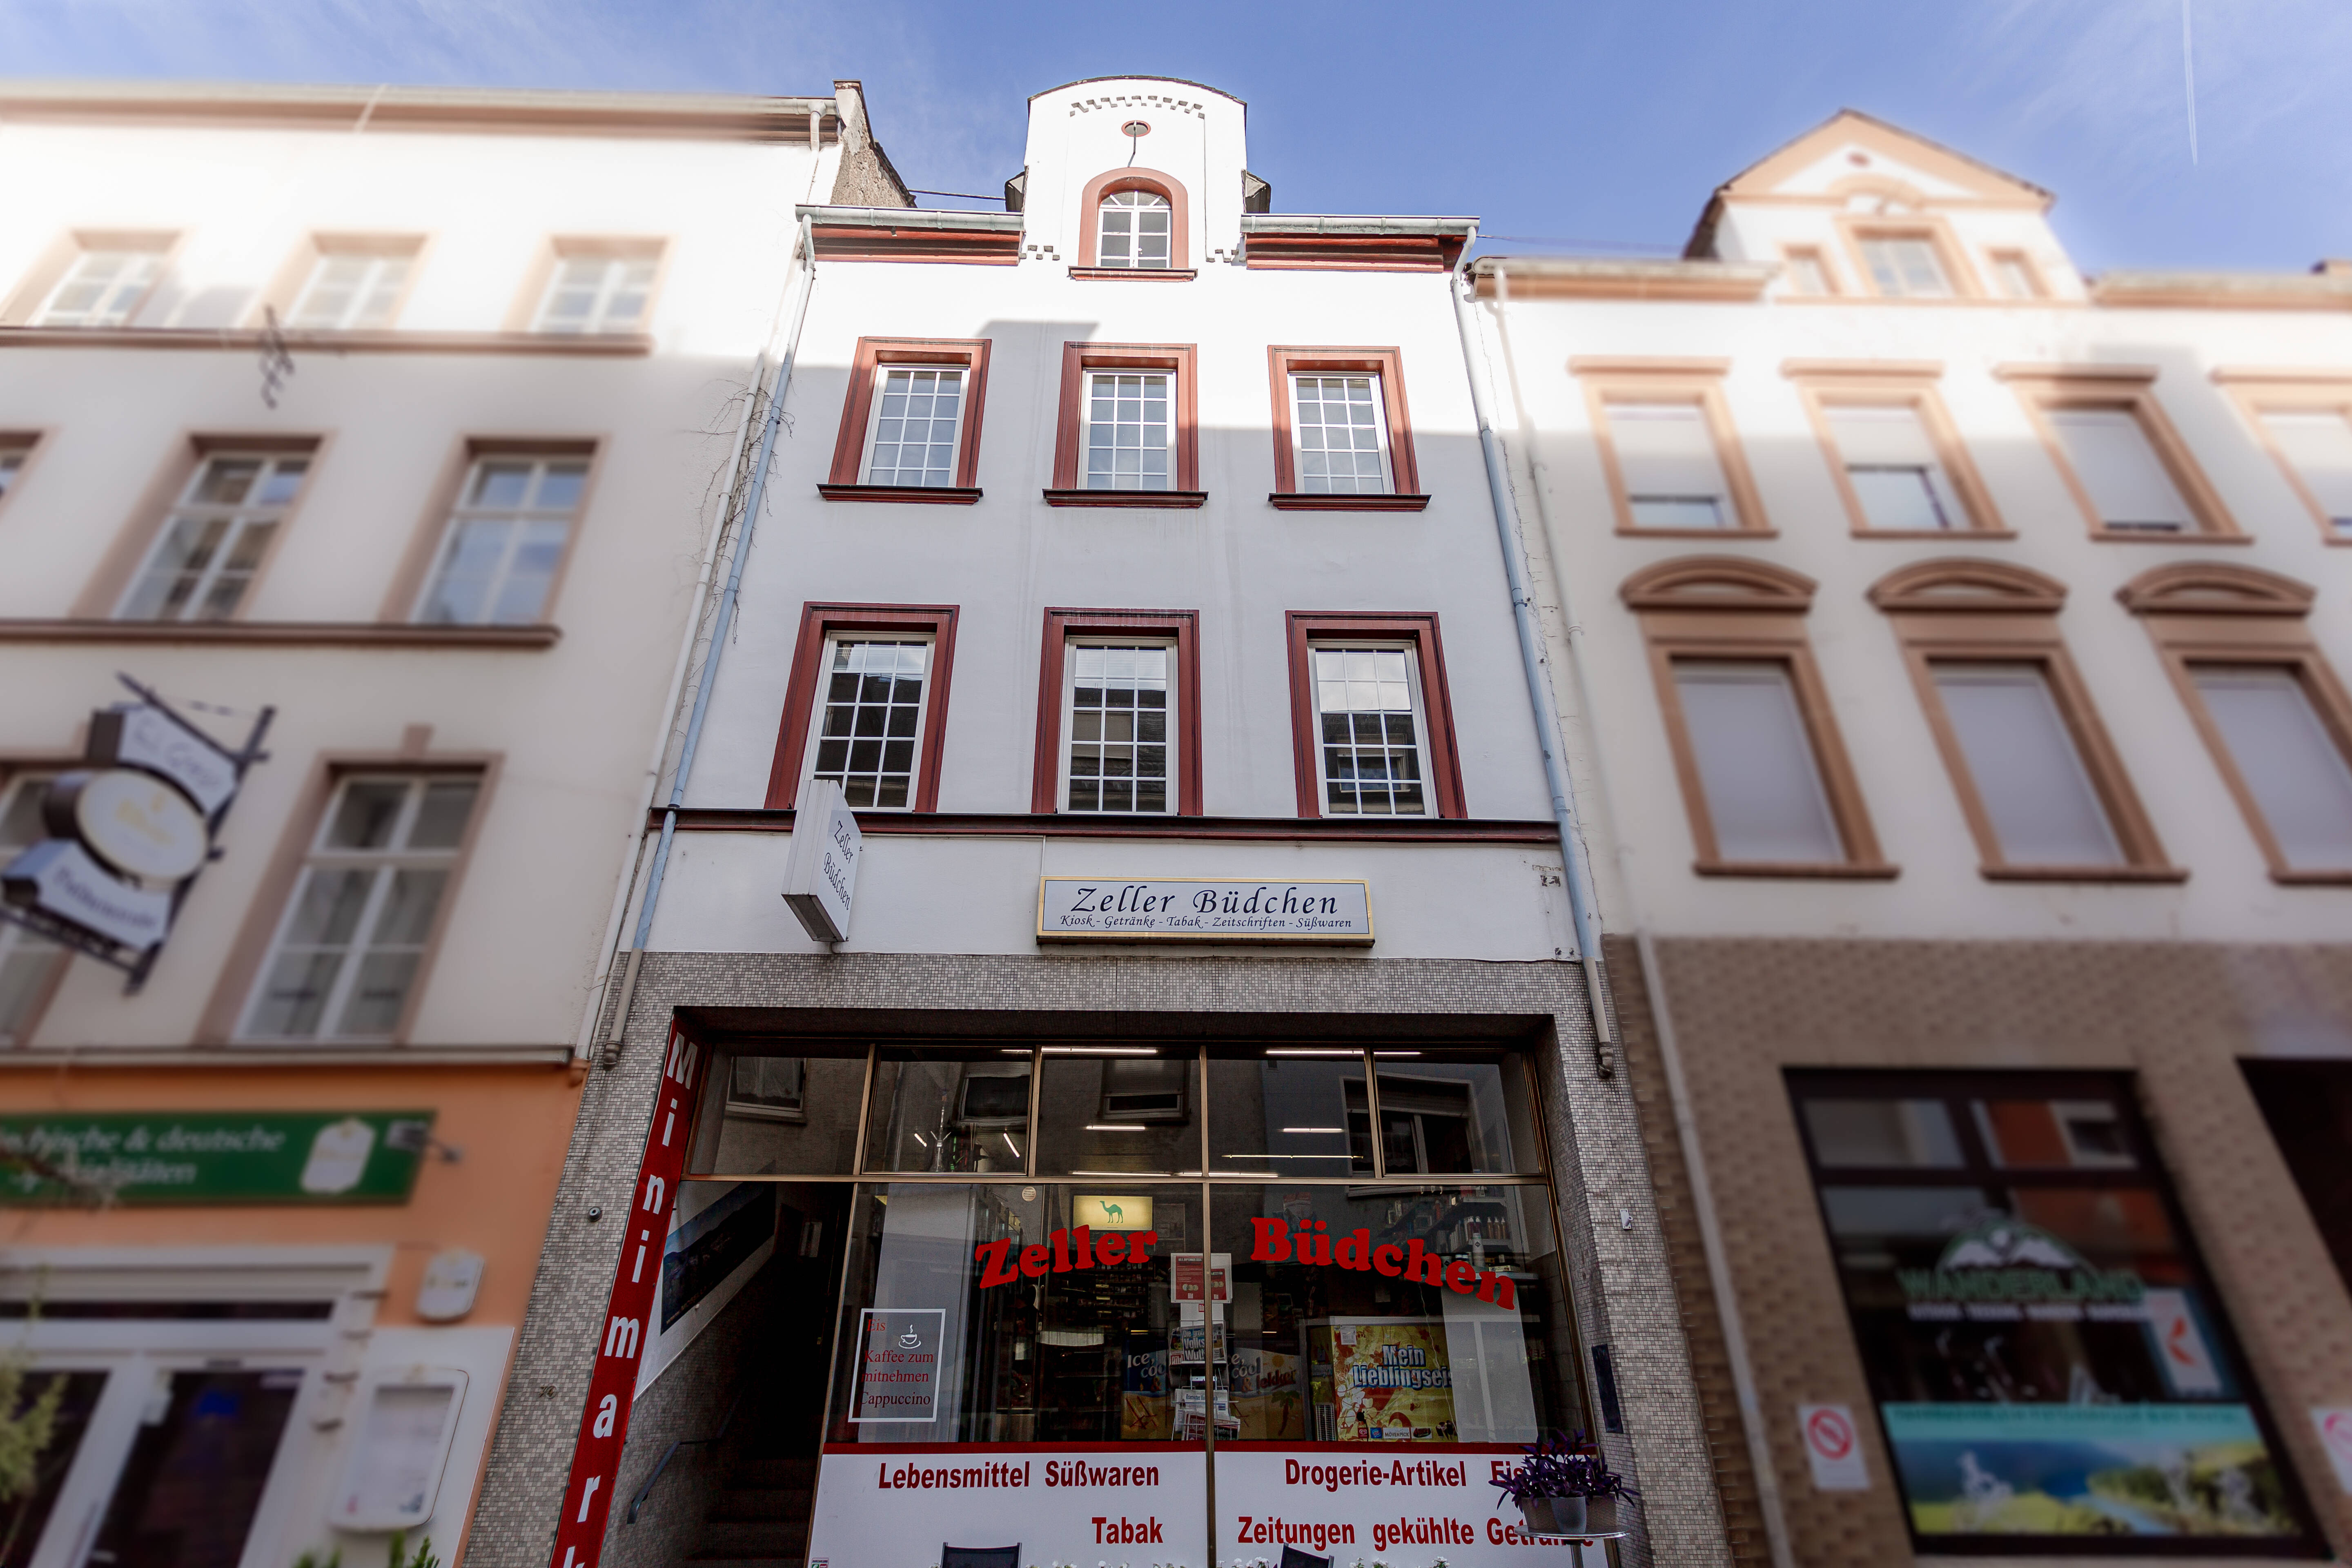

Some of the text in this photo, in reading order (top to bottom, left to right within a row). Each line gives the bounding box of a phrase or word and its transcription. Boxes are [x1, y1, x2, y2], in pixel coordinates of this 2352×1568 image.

[834, 820, 853, 864] Zeller
[824, 852, 850, 910] Büdchen
[1070, 885, 1338, 914] Zeller Büdchen
[1060, 914, 1095, 927] Kiosk
[1105, 915, 1155, 929] Getränke
[1166, 915, 1204, 929] Tabak
[1212, 915, 1285, 929] Zeitschriften
[1296, 917, 1352, 929] Süßwaren
[975, 1217, 1515, 1310] Zeller Büdchen
[866, 1319, 886, 1332] Eis
[864, 1350, 933, 1363] Kaffee zum
[1127, 1353, 1155, 1368] Ice,
[1382, 1345, 1425, 1366] Mein
[861, 1369, 929, 1383] mitnehmen
[1140, 1364, 1165, 1378] coo
[1231, 1356, 1261, 1379] cool
[861, 1392, 931, 1408] Cappuccino
[879, 1460, 1159, 1489] Lebensmittel Süßwaren
[1285, 1459, 1466, 1492] Drogerie-Artikel
[1091, 1516, 1163, 1544] Tabak
[1238, 1516, 1355, 1551] Zeitungen
[1373, 1517, 1474, 1552] gekühlte
